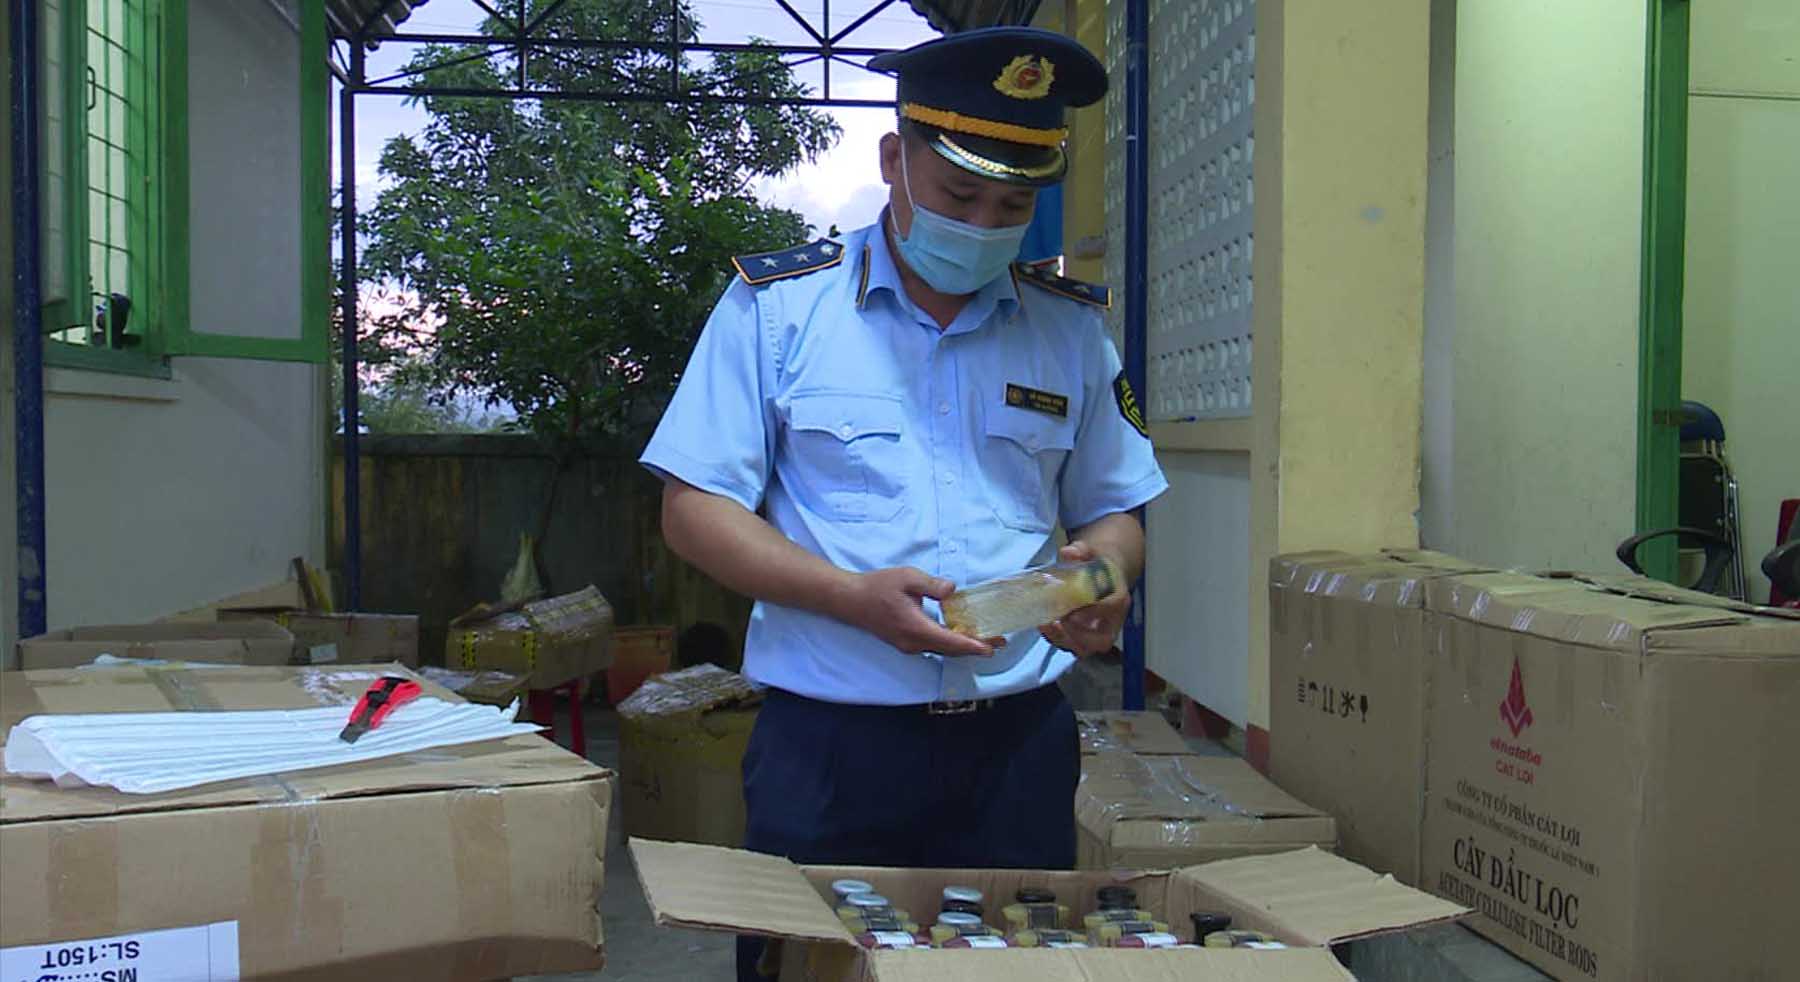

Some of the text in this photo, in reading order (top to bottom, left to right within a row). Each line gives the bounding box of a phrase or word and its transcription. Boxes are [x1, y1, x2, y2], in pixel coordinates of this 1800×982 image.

[1454, 836, 1579, 929] CÂY ĐẦU LỌC
[40, 941, 140, 969] SL:150T
[1529, 919, 1566, 961] FILTER
[1567, 940, 1598, 978] RODS
